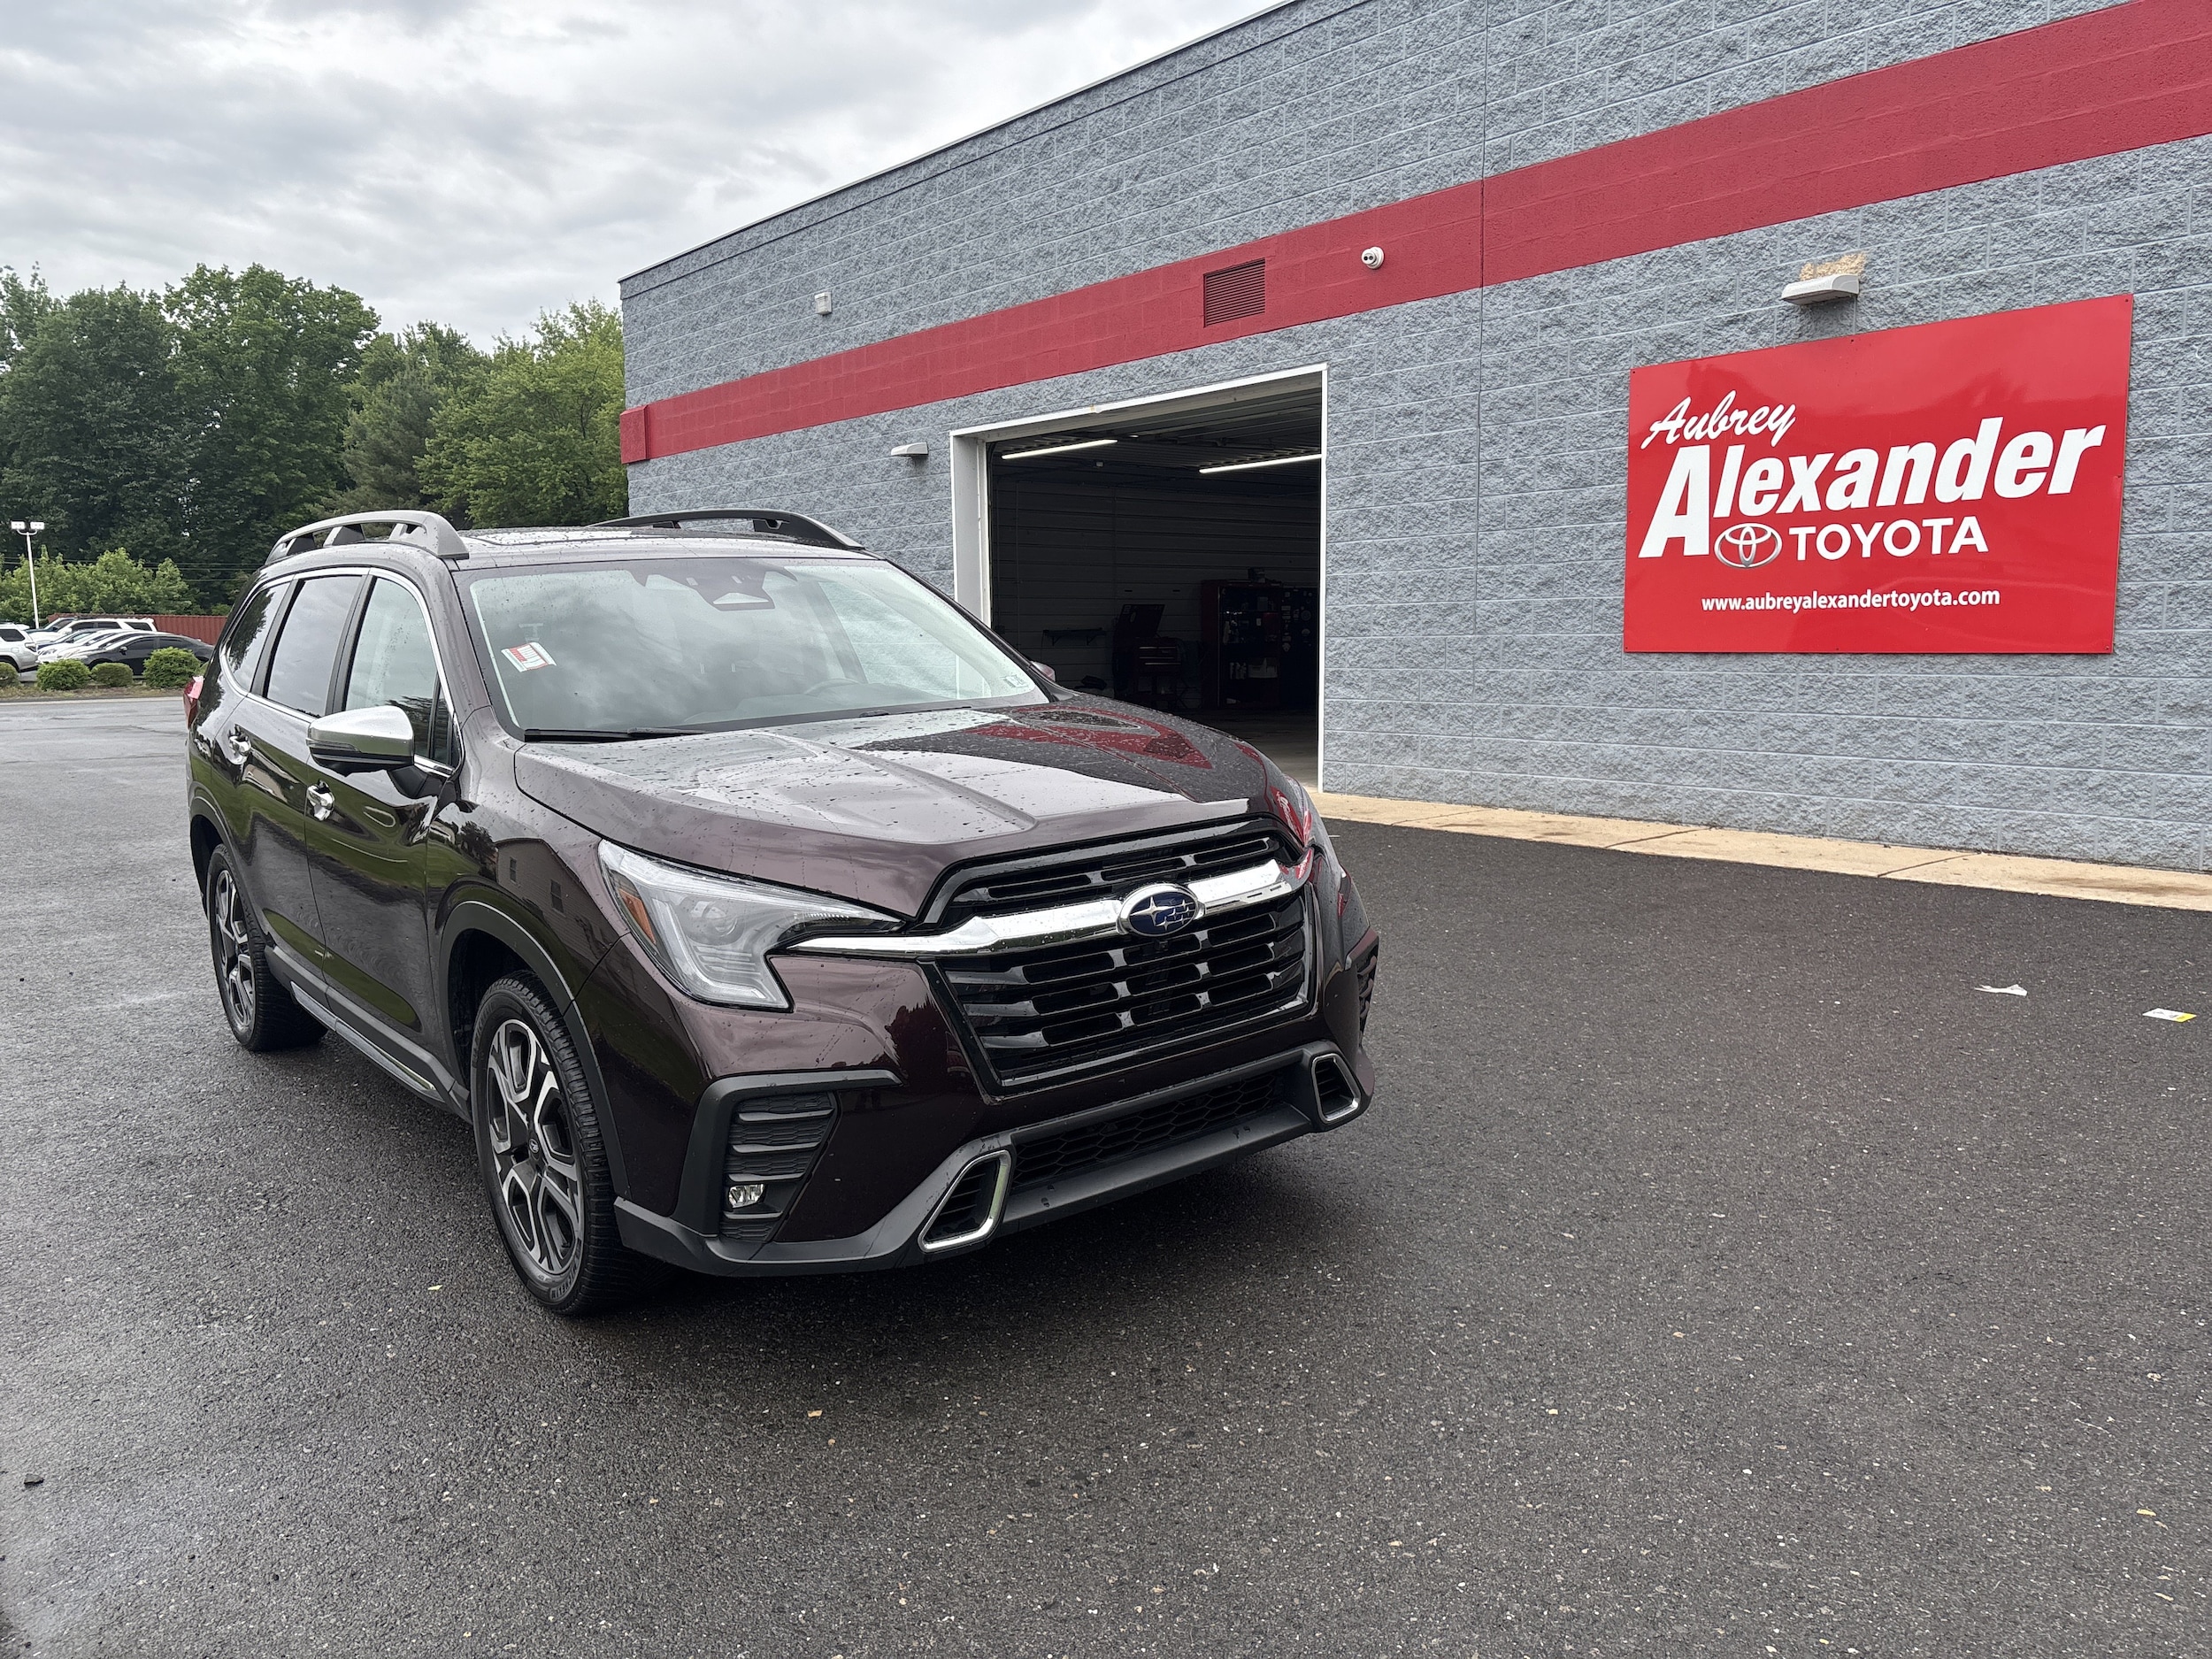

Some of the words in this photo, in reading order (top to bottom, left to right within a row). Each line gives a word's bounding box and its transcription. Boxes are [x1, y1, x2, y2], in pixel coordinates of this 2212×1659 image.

[1640, 389, 1796, 449] Aubrey
[1638, 416, 2107, 558] Alexander
[1788, 516, 1989, 561] TOYOTA
[1701, 588, 2001, 614] www.aubreyalexandertoyota.com
